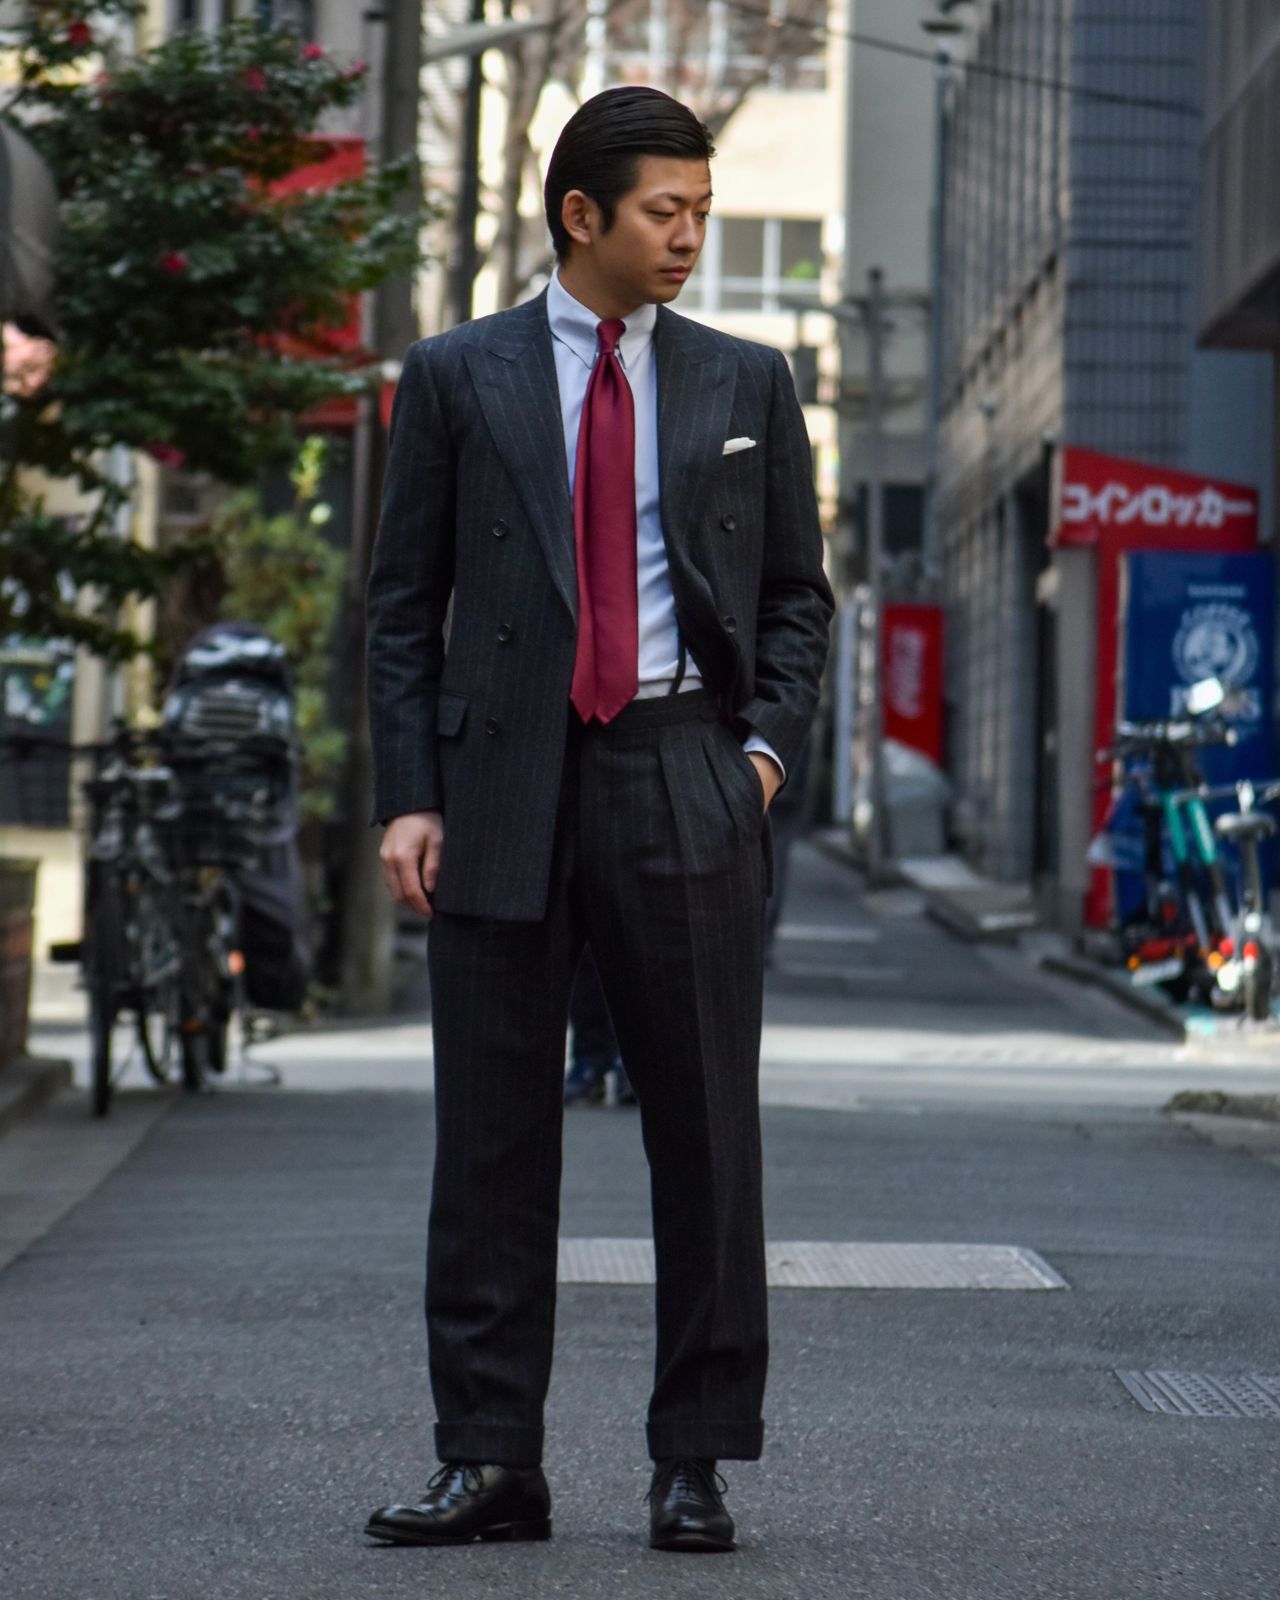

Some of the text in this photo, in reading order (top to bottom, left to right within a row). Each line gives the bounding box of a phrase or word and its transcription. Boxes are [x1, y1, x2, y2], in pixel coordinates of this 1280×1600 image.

[1063, 482, 1253, 527] コインロッカー
